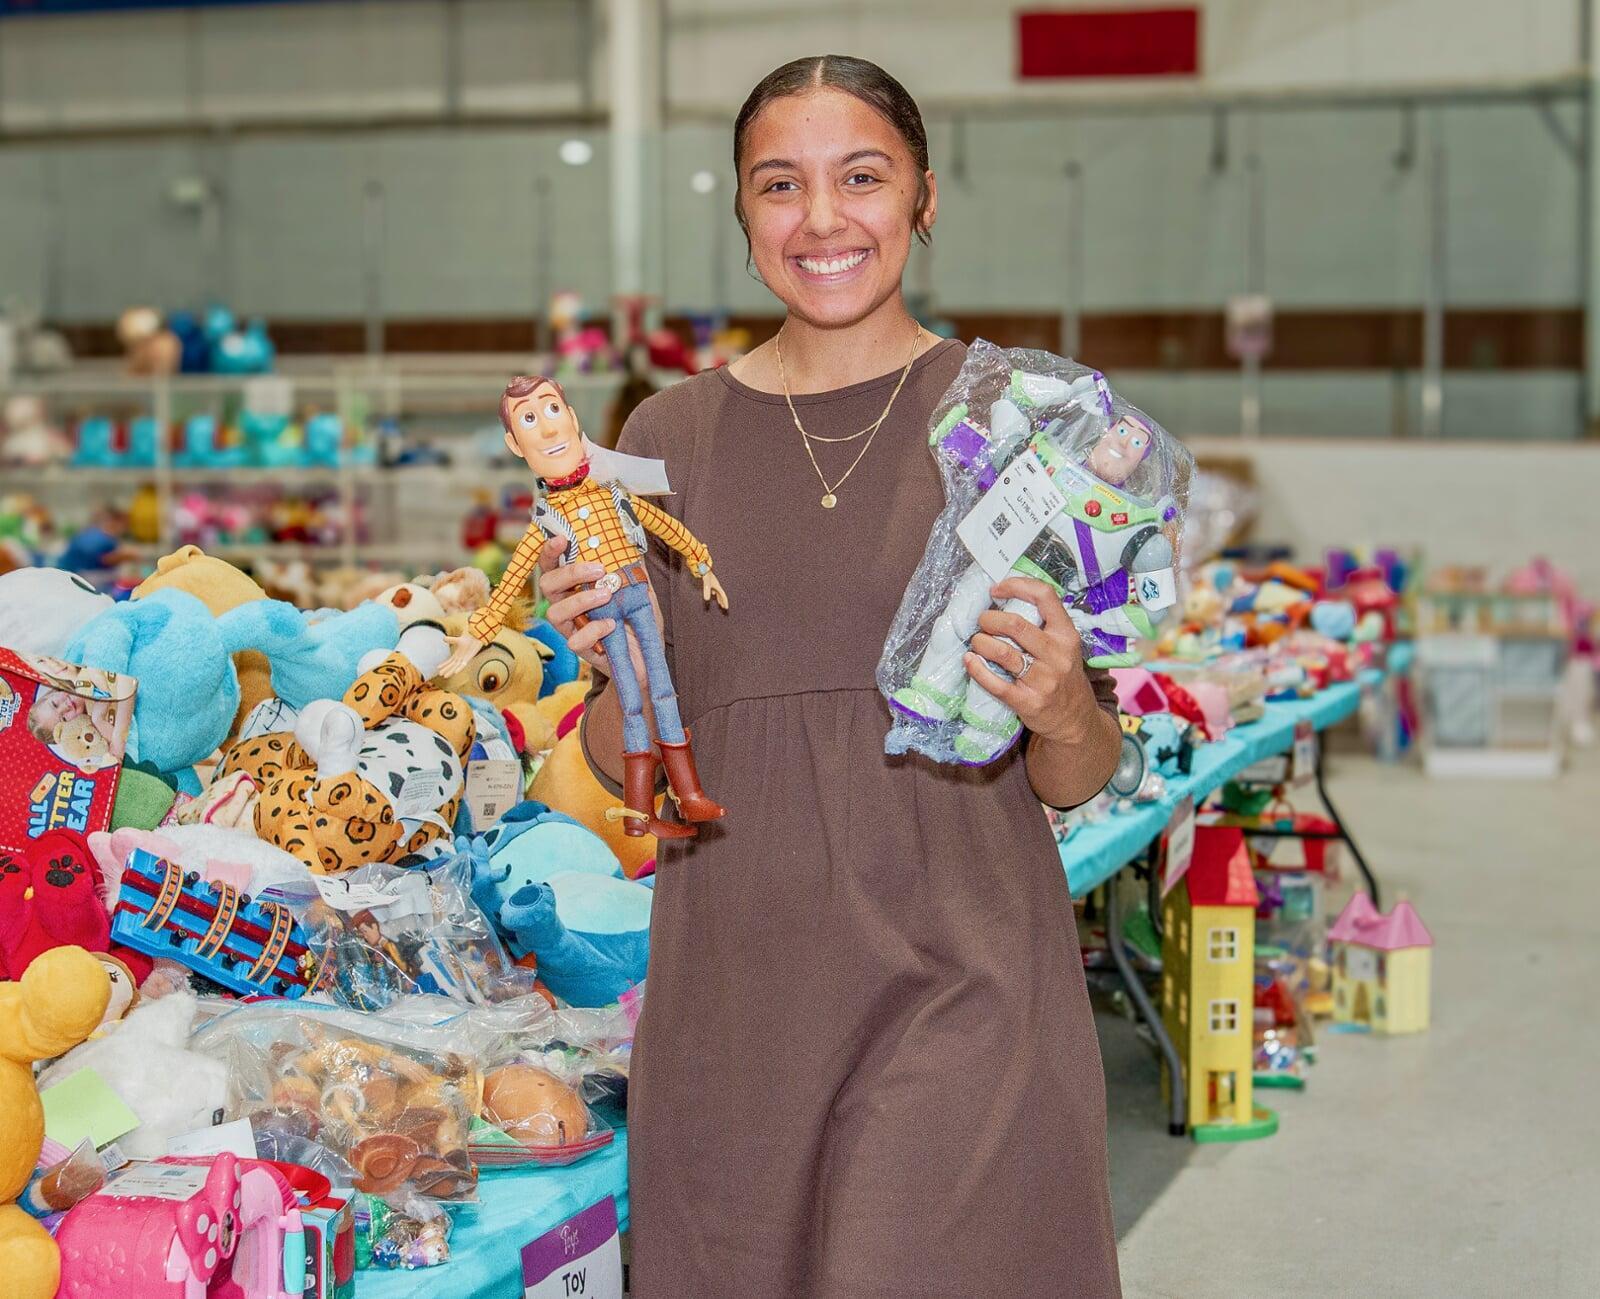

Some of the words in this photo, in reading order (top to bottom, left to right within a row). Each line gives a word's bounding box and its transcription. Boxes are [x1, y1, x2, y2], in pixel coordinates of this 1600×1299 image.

[28, 799, 48, 838] ALL
[48, 770, 76, 831] TTER
[67, 778, 95, 832] EAR
